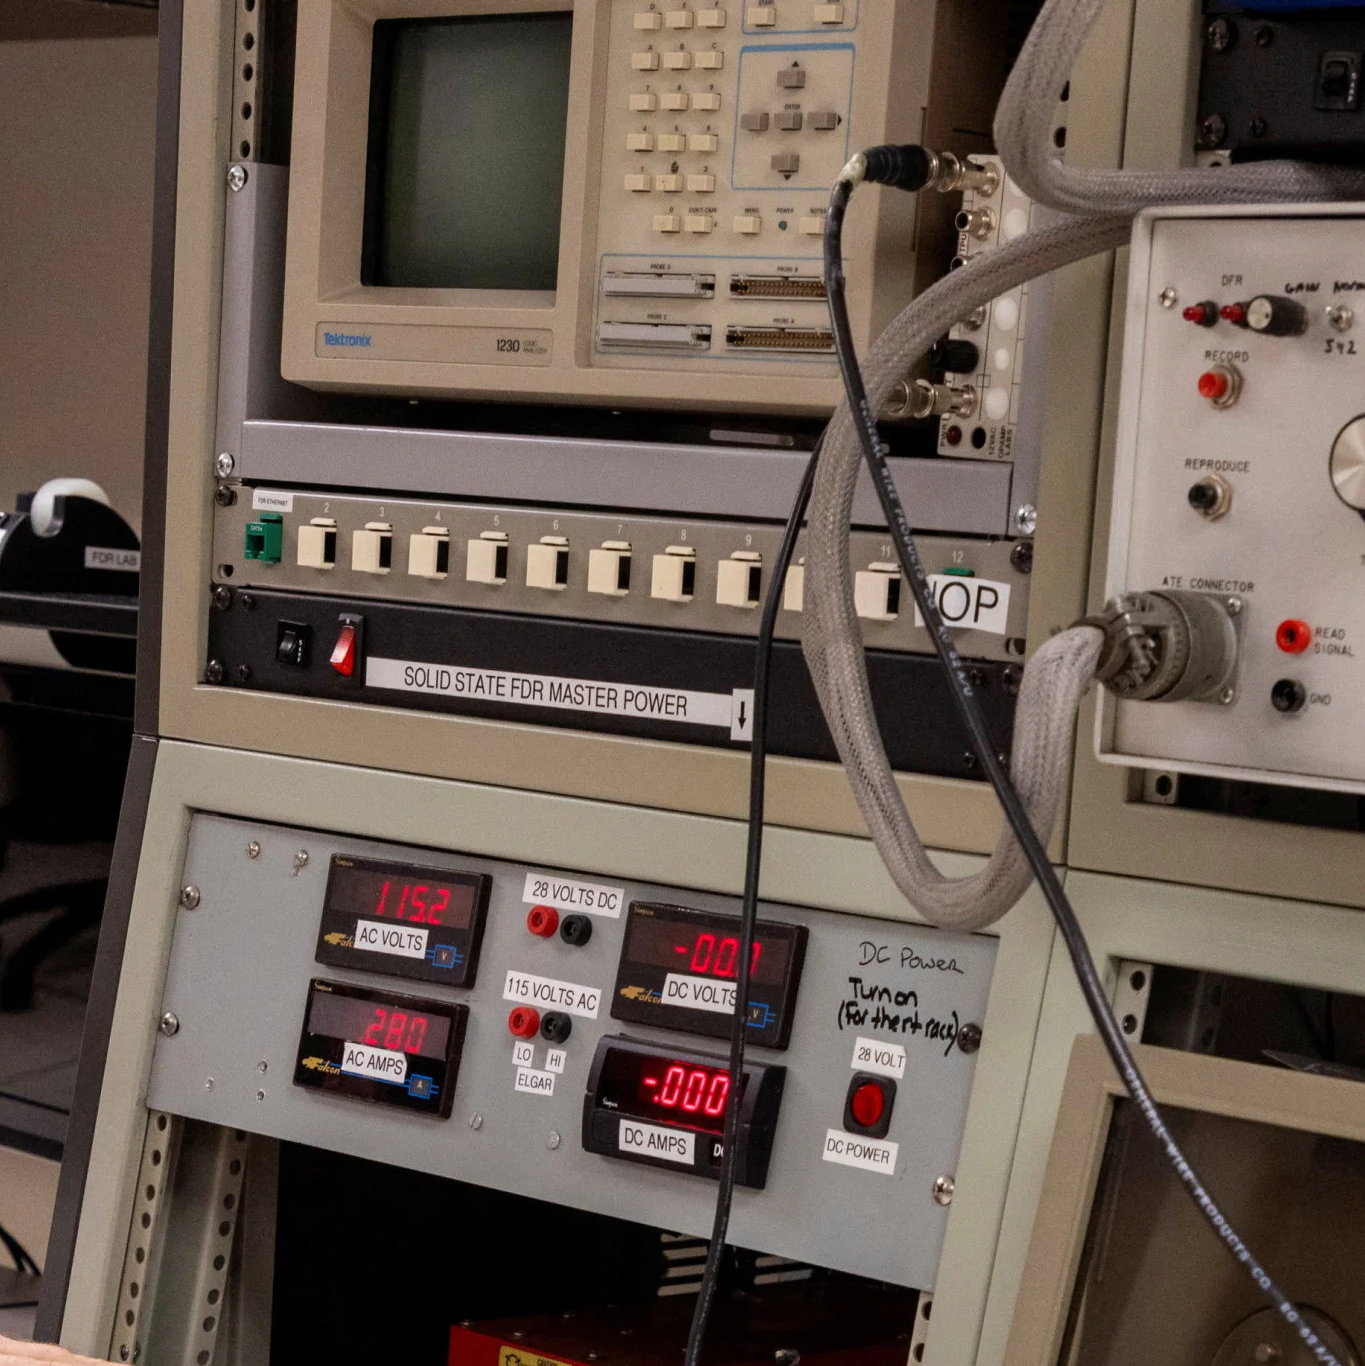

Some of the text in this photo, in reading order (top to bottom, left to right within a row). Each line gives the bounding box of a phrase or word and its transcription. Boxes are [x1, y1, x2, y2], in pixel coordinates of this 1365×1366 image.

[1221, 275, 1243, 286] DFR
[323, 332, 371, 347] Tektronix
[496, 339, 520, 352] 1230
[1205, 350, 1249, 363] RECORD
[1185, 459, 1250, 473] REPRODUCE
[323, 502, 329, 513] 2
[952, 550, 964, 563] 12
[1162, 576, 1255, 593] ATE CONNECTOR
[1316, 626, 1345, 640] READ
[1314, 643, 1355, 657] SIGNAL
[404, 666, 688, 717] SOLID STATE FDR MASTER POWER
[533, 881, 617, 909] 28 VOLTS DC
[359, 927, 423, 951] AC VOLTS
[858, 941, 890, 966] DC
[508, 978, 597, 1011] 115 VOLTS AC
[668, 981, 737, 1006] DC VOLTS
[346, 1049, 404, 1075] AC AMPS
[517, 1047, 531, 1061] LO
[550, 1055, 561, 1067] HI
[857, 1047, 905, 1069] 28 VOLT
[518, 1073, 553, 1091] ELGAR
[624, 1127, 687, 1155] DC AMPS
[827, 1139, 890, 1164] DC POWER
